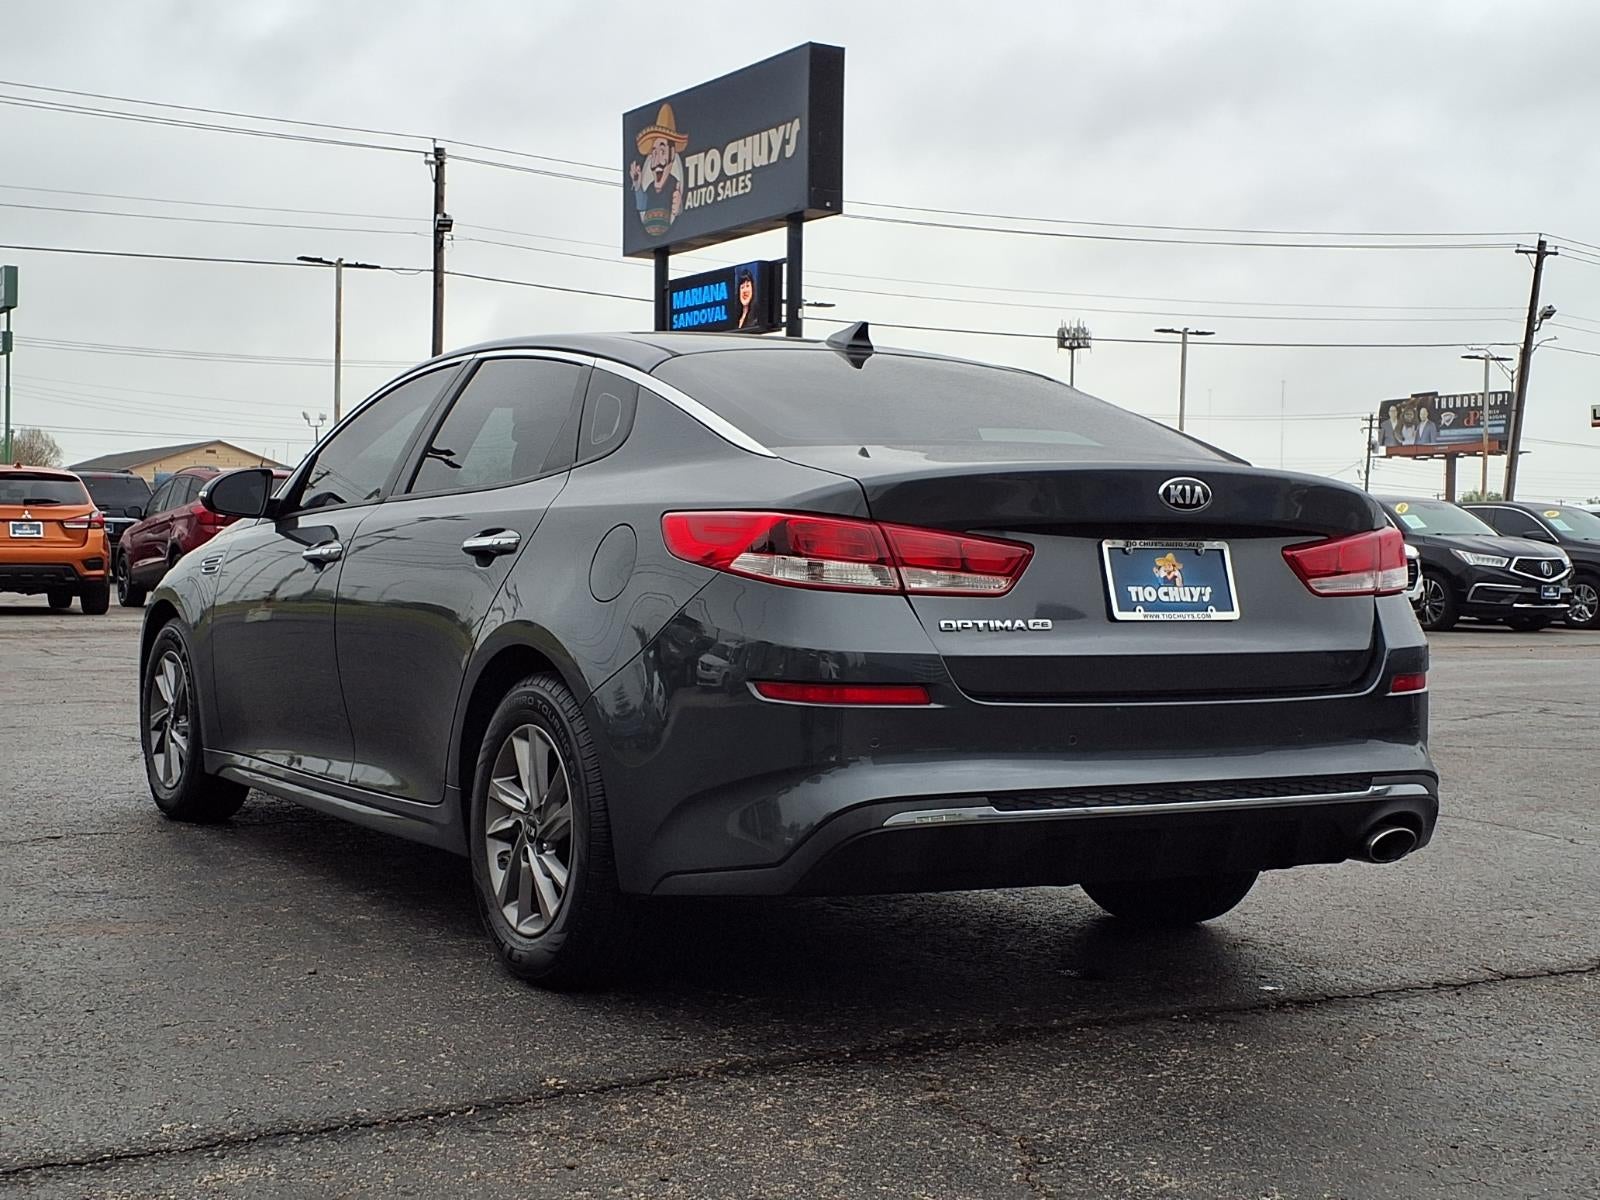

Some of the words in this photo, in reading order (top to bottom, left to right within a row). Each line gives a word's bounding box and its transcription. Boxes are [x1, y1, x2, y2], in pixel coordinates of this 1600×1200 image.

[685, 149, 721, 188] TIO
[723, 118, 800, 176] CHUY'S
[685, 186, 714, 210] AUTO
[717, 174, 752, 201] SALES
[672, 282, 728, 310] MARIANA
[672, 305, 728, 330] SANDOVAL
[1434, 394, 1483, 409] THUNDER
[1489, 393, 1508, 406] UP!
[1169, 484, 1205, 505] KIA
[1127, 586, 1157, 602] TIO
[1158, 586, 1212, 602] CHUY'S
[940, 619, 1027, 631] OPTIMA
